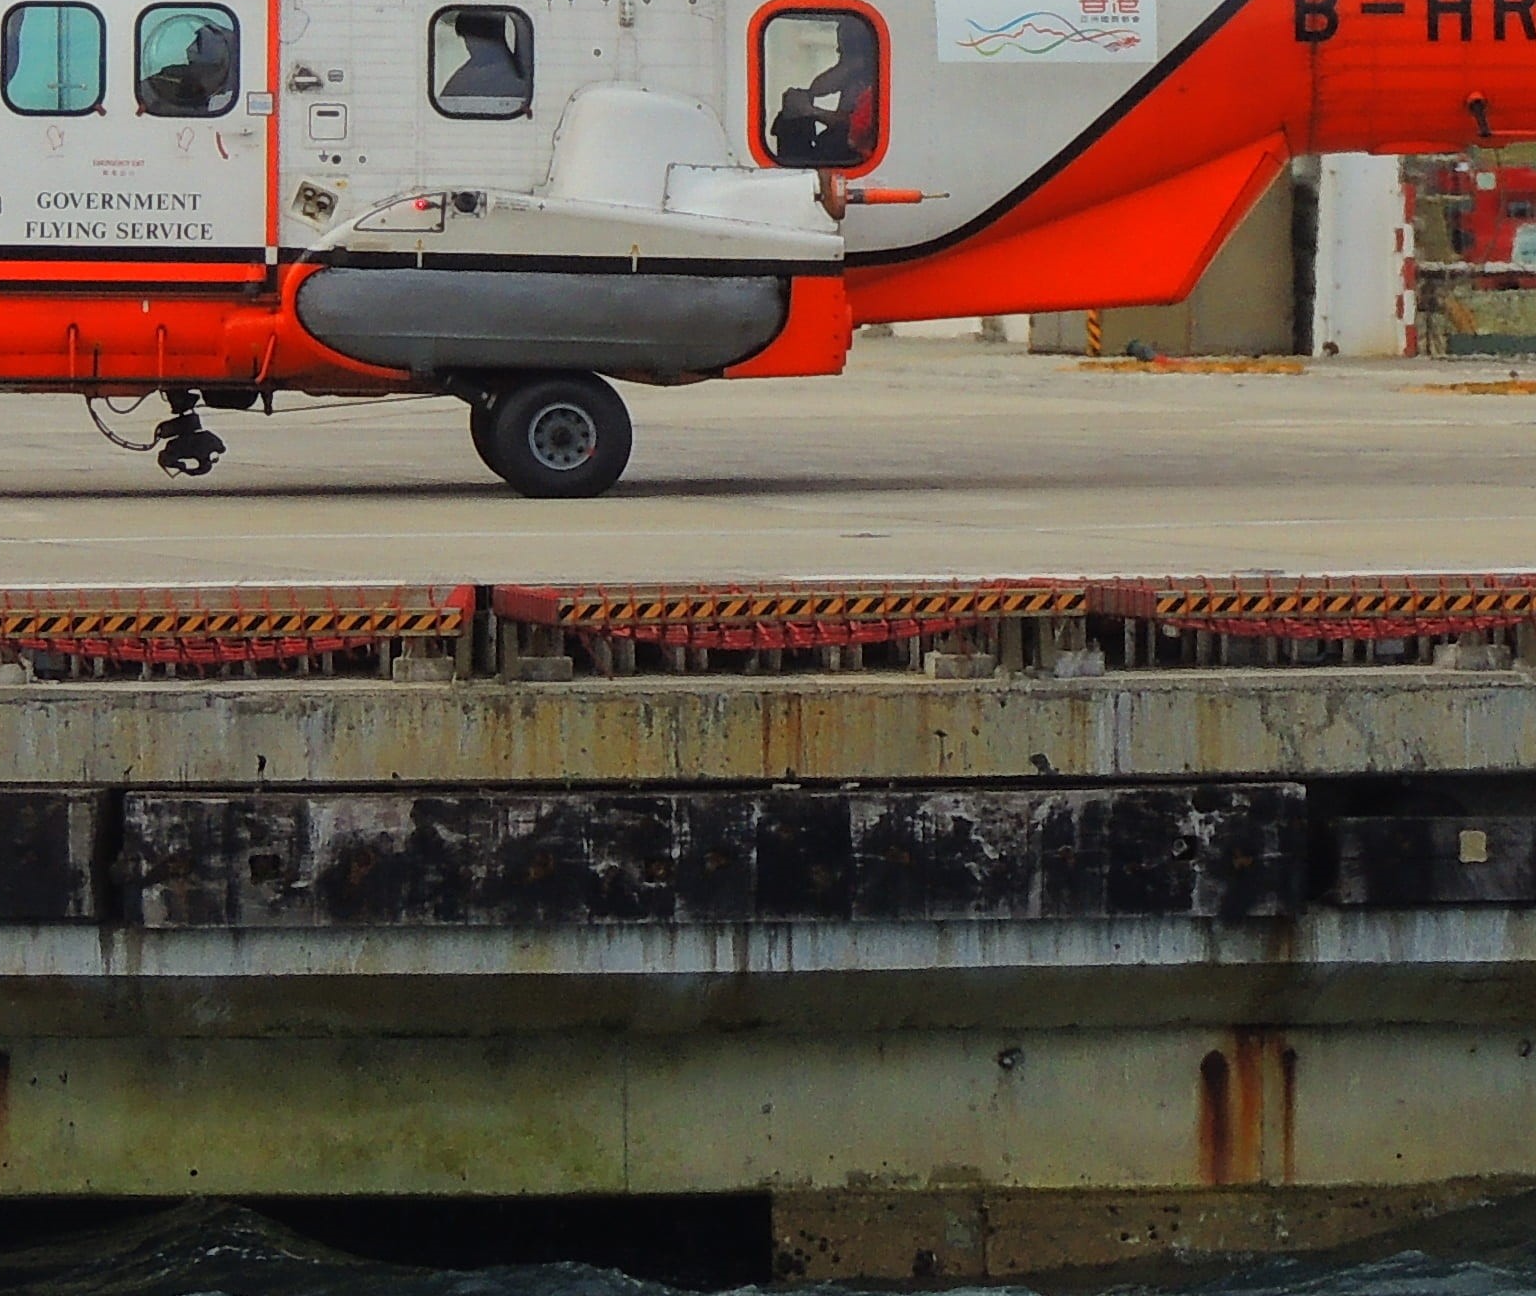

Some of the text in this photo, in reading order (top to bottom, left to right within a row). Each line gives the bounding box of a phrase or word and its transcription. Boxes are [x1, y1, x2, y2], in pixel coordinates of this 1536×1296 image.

[37, 192, 201, 211] GOVERNMENT
[26, 221, 213, 241] FLYING SERVICE
